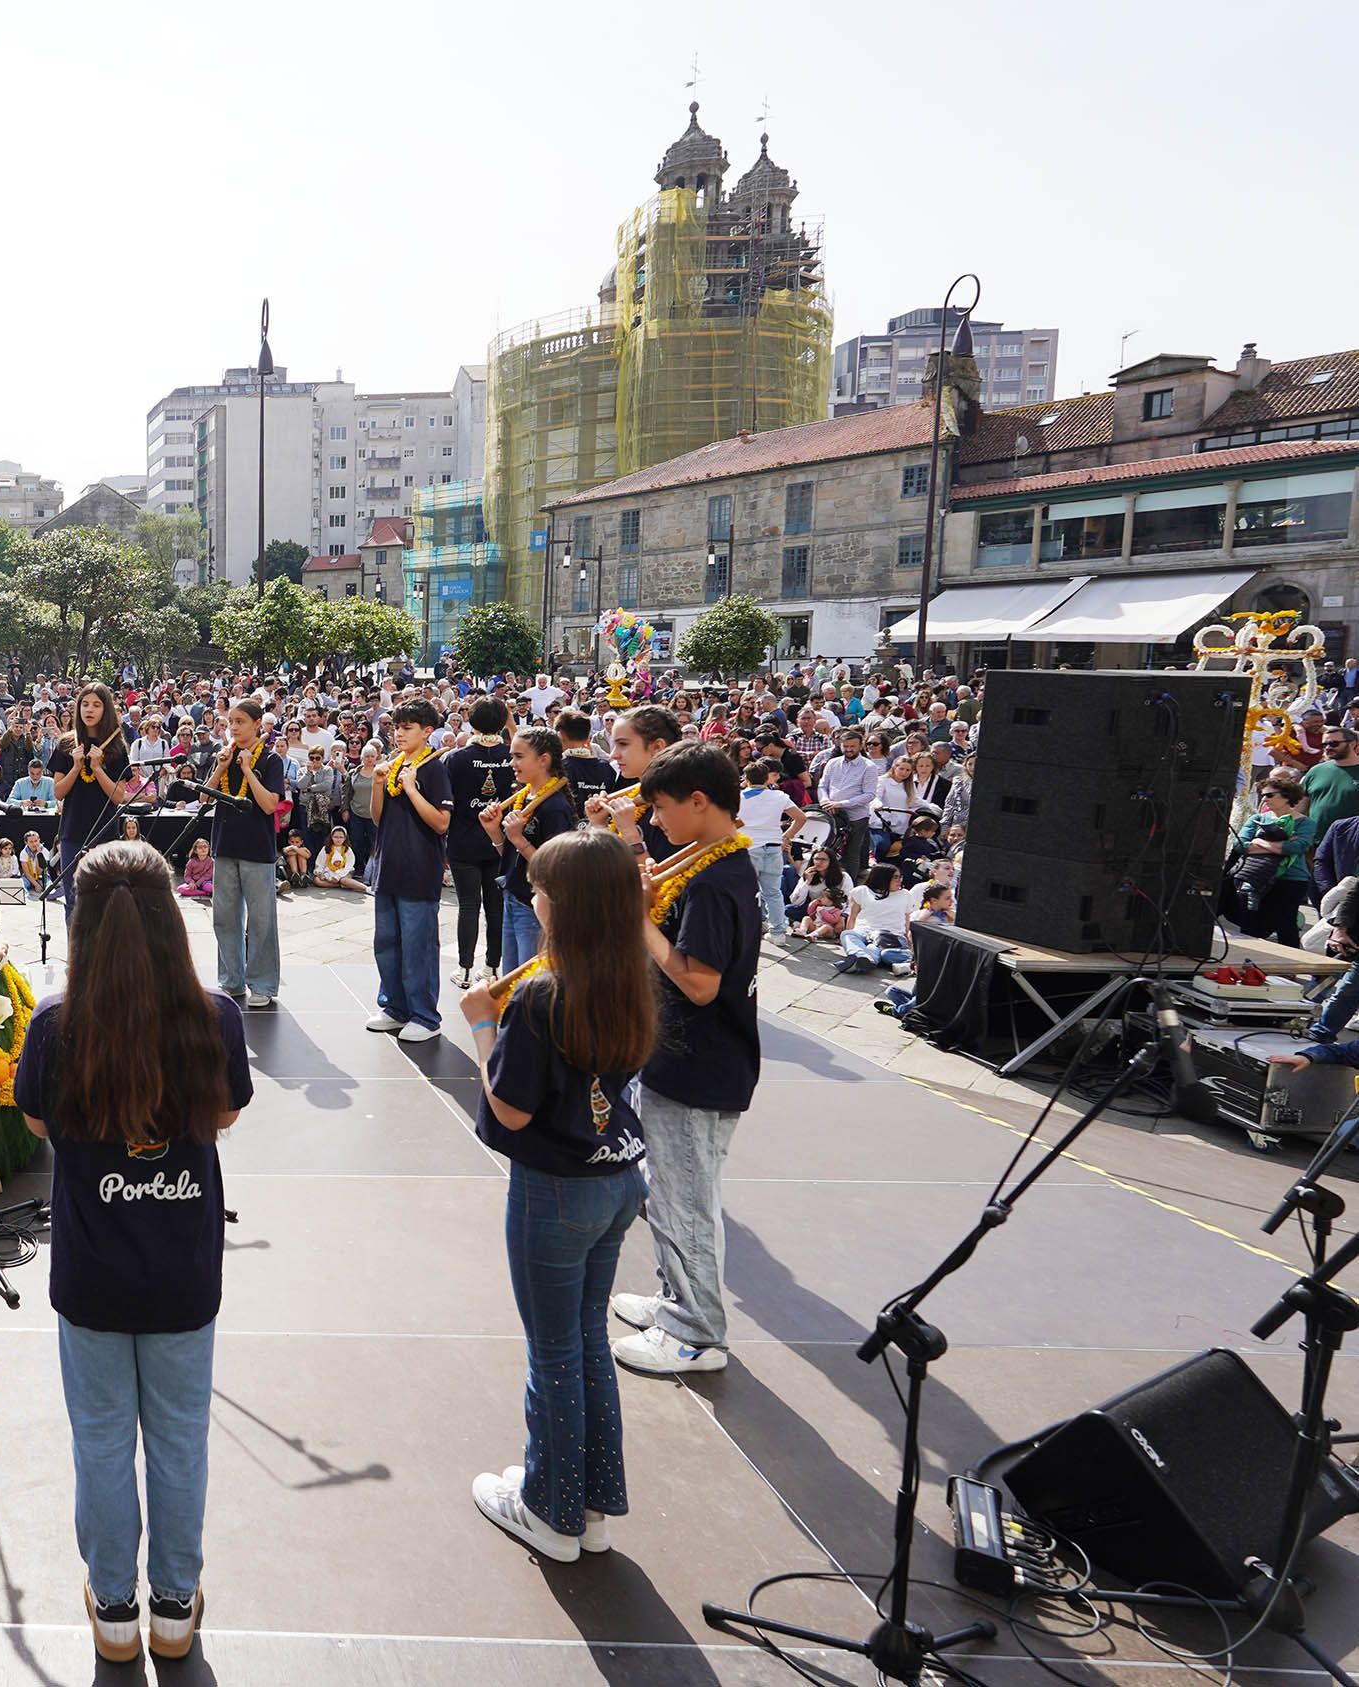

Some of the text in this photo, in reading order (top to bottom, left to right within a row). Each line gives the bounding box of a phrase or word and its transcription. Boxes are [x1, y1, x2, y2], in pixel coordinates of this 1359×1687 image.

[472, 759, 501, 768] Marcos
[99, 1169, 202, 1204] Portela
[1130, 1428, 1165, 1468] NEXO
